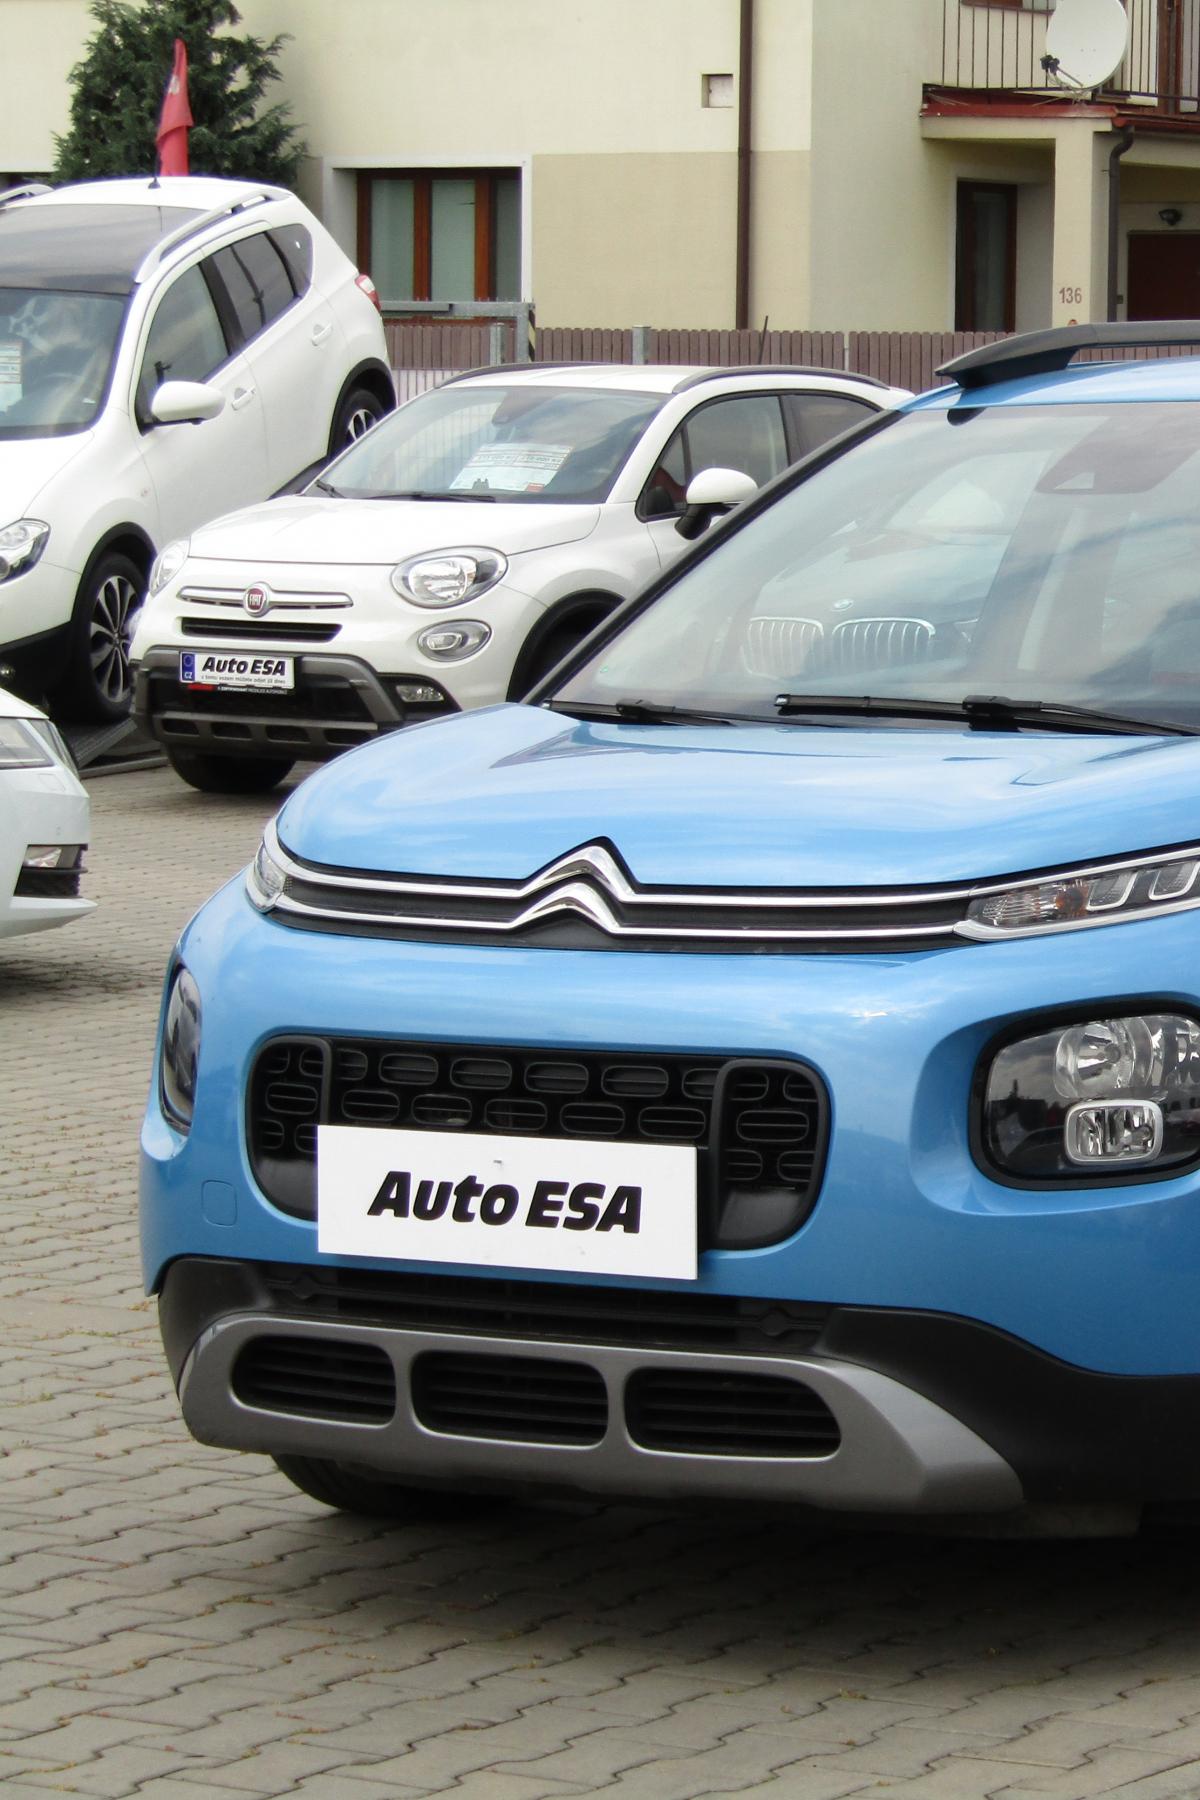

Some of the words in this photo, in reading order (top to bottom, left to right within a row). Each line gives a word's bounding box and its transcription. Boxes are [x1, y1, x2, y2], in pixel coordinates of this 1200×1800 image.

[1059, 287, 1082, 304] 136
[202, 656, 249, 674] Auto
[250, 659, 286, 676] ESA
[367, 1171, 519, 1226] Auto
[525, 1180, 642, 1234] ESA
